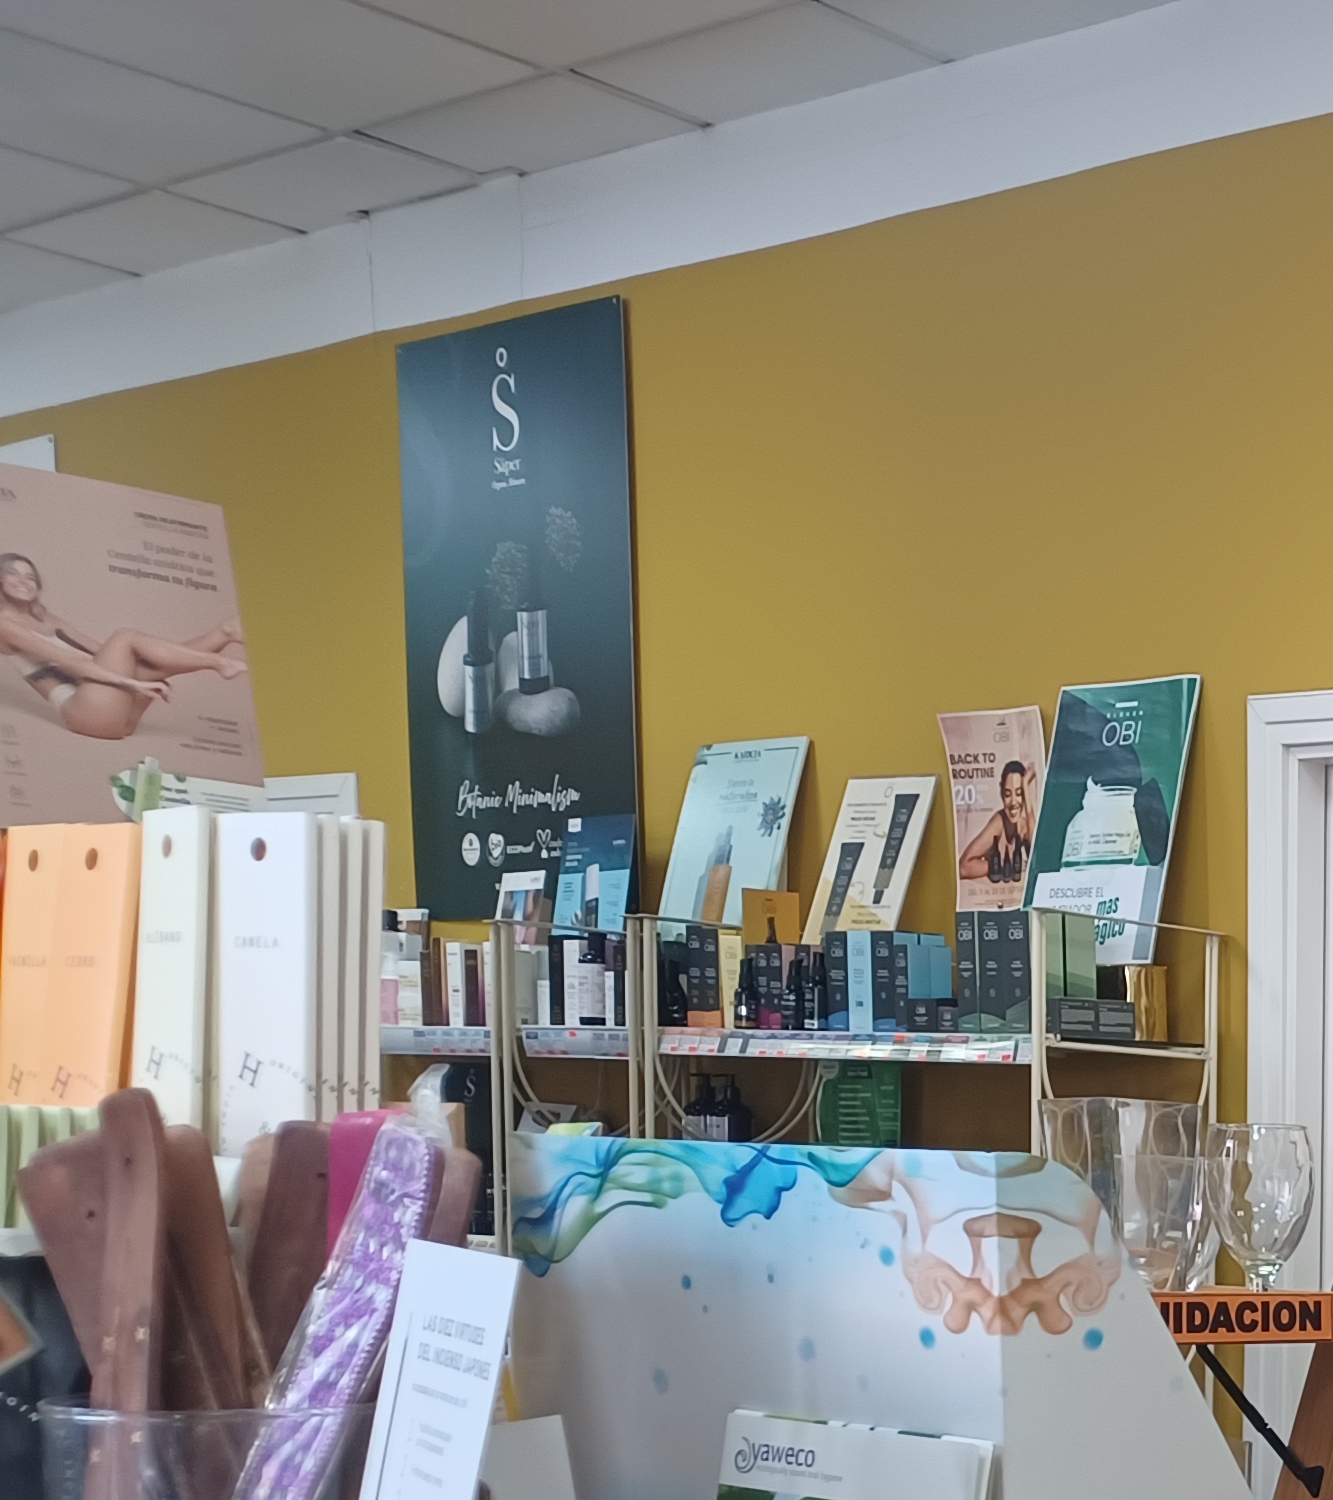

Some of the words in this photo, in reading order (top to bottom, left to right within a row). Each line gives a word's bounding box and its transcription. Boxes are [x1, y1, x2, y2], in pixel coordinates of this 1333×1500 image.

[1102, 720, 1142, 747] OBI
[950, 753, 980, 766] BACK
[982, 752, 996, 764] TO
[952, 767, 996, 780] ROUTINE
[955, 785, 977, 805] 20
[1049, 887, 1094, 900] DESCUBRE
[233, 936, 280, 950] CANELA
[1160, 1300, 1322, 1334] IDACION
[746, 1441, 816, 1470] yaweco
